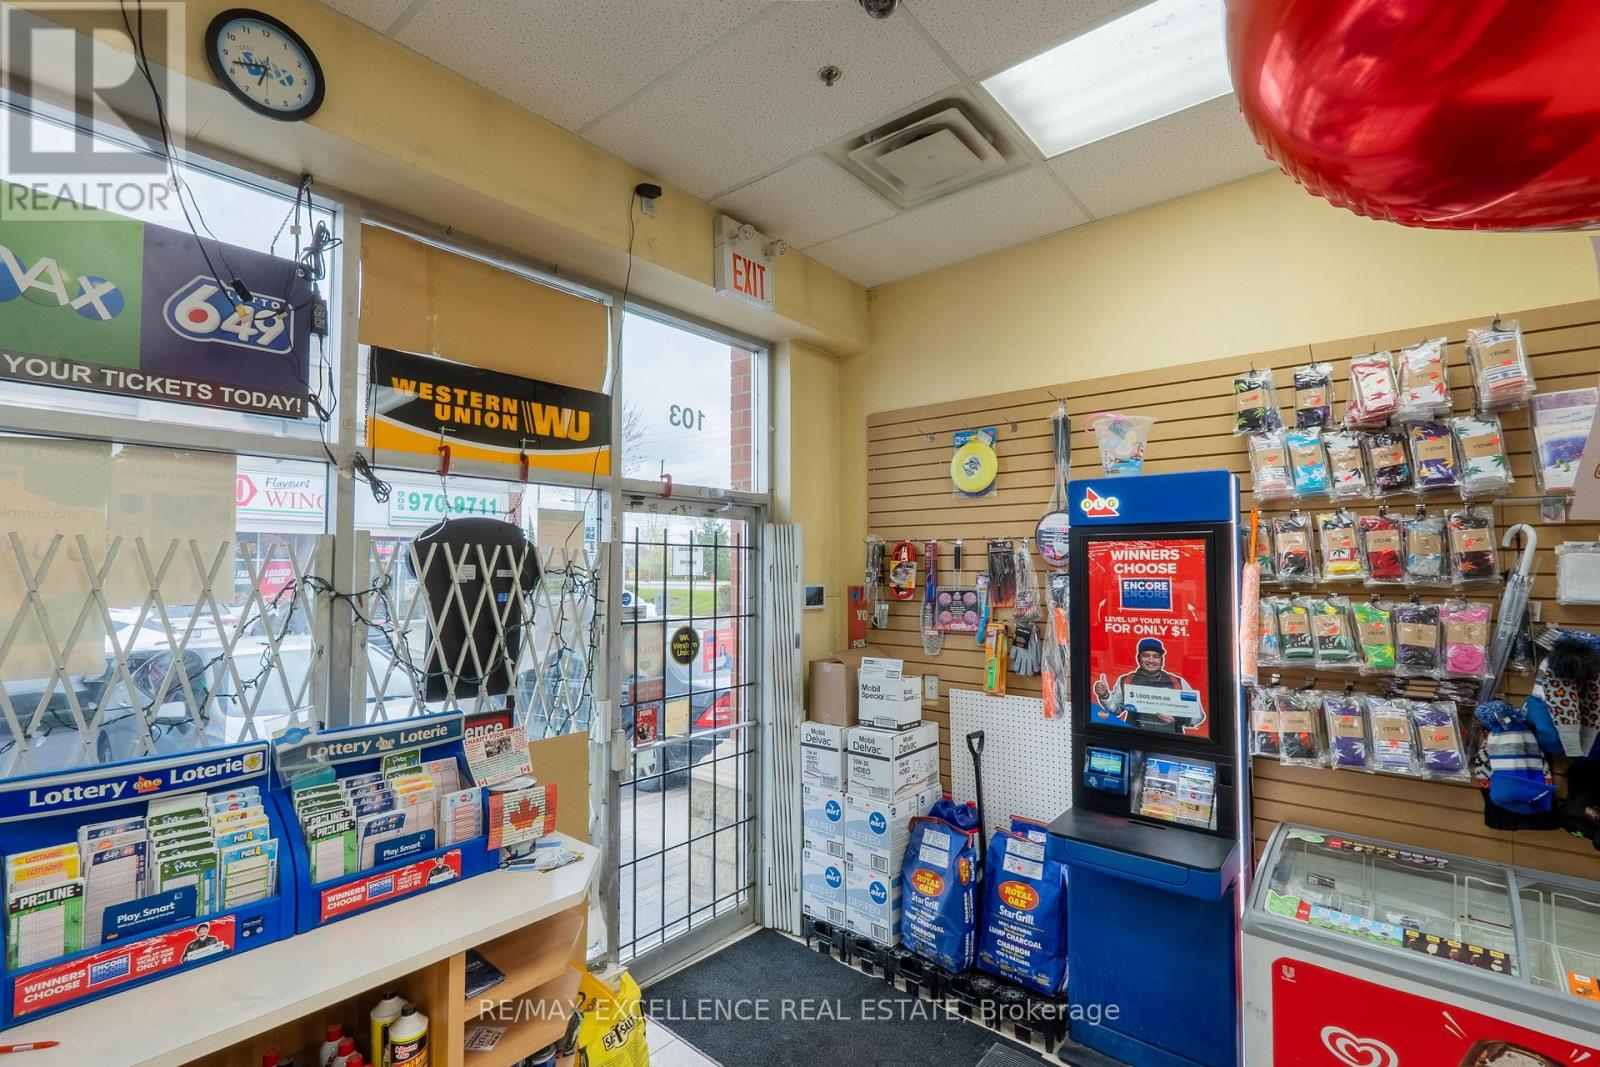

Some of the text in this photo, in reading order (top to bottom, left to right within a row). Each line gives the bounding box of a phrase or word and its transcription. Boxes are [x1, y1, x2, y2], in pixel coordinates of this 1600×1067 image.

[241, 25, 251, 34] 11
[262, 29, 271, 38] 12
[732, 252, 766, 301] EXIT
[2, 354, 302, 412] YOUR TICKETS TODAY!
[391, 376, 519, 415] WESTERN
[434, 403, 518, 432] UNION
[531, 402, 591, 442] WU
[265, 477, 311, 488] Flavours
[1082, 498, 1117, 509] OLG
[1110, 548, 1180, 561] WINNERS
[1113, 562, 1177, 574] CHOOSE
[1123, 581, 1169, 591] ENCORE
[1104, 615, 1190, 626] LEVEL UP YOUR TICKET
[1104, 623, 1190, 638] FOR ONLY $1.
[861, 683, 881, 693] Mobil
[861, 691, 885, 701] Special
[464, 725, 527, 746] CHARITY FOOD SUPPLY
[810, 727, 826, 737] Mobil
[306, 738, 371, 759] Lottery
[400, 724, 449, 745] Loterie
[805, 733, 831, 746] Delvac
[859, 735, 876, 744] Mobil
[853, 741, 882, 755] Delvac
[898, 741, 917, 754] Delvac
[29, 780, 128, 808] Lottery
[169, 759, 243, 785] Loterie
[400, 841, 421, 852] Smart
[916, 875, 940, 889] ROYAL
[327, 885, 366, 903] WINNERS
[918, 884, 934, 895] OAK
[1004, 886, 1033, 902] ROYAL
[327, 893, 363, 910] CHOOSE
[1008, 896, 1027, 909] OAK
[143, 902, 176, 917] Smart
[999, 904, 1035, 926] StarGrill
[988, 925, 1043, 950] LUMP CHARCOAL
[996, 939, 1031, 957] CHARBON
[92, 956, 128, 972] ENCORE
[136, 960, 160, 972] ONLY
[24, 969, 86, 994] WINNERS
[23, 979, 81, 1004] CHOOSE
